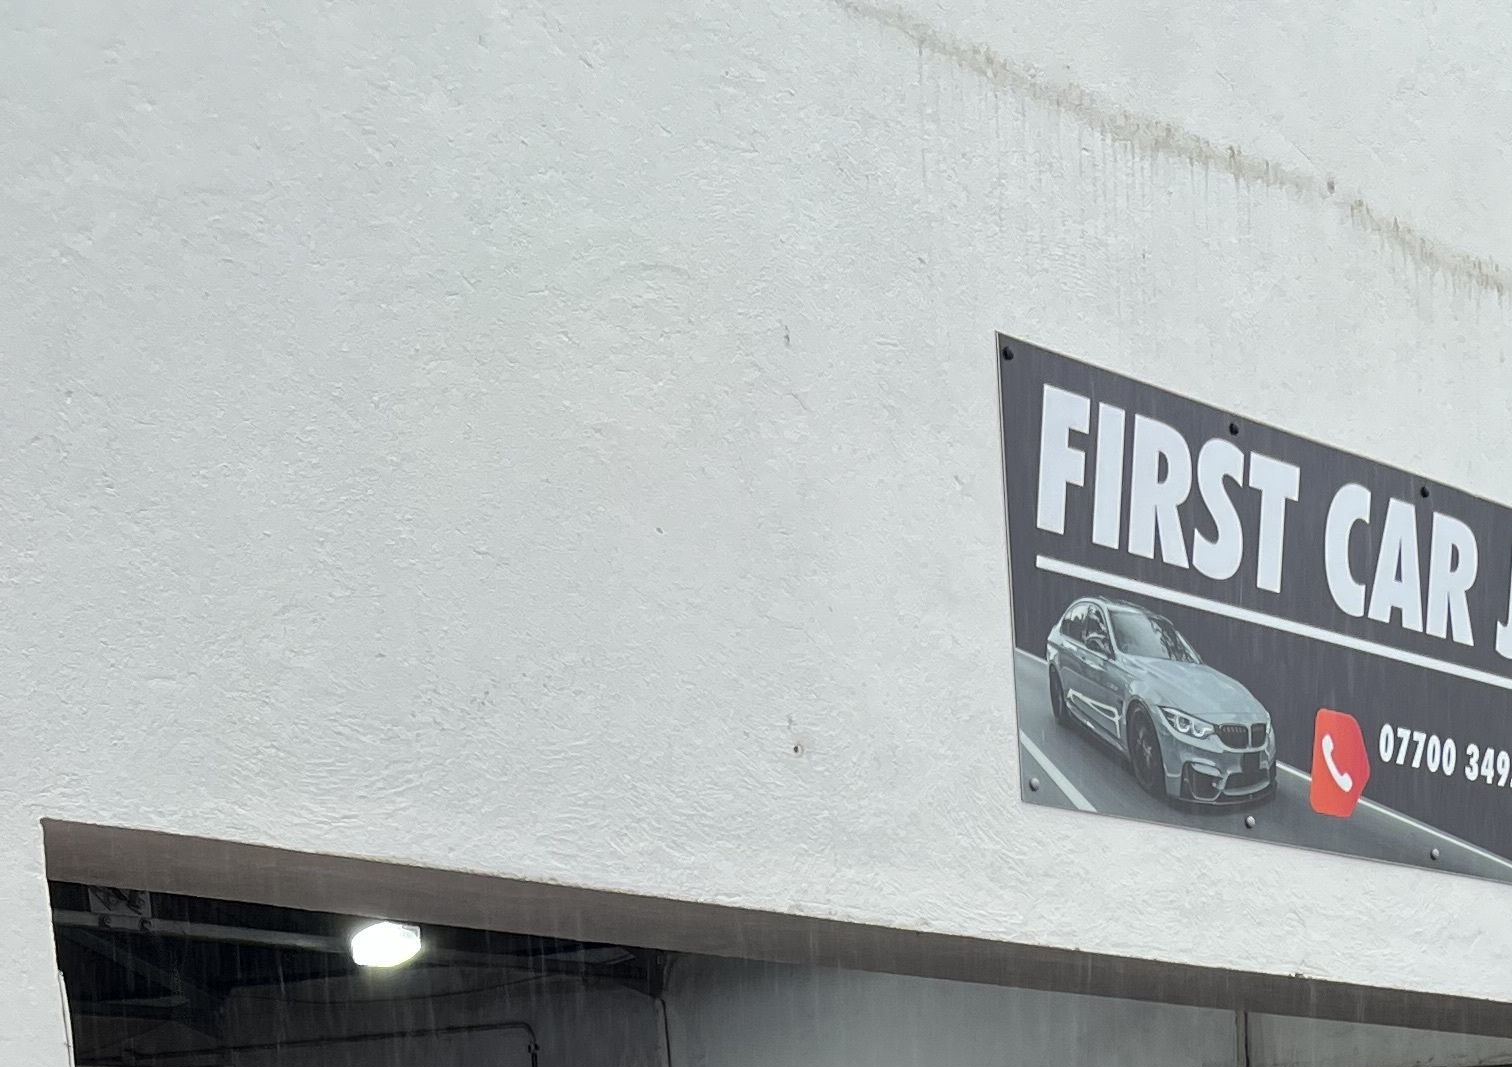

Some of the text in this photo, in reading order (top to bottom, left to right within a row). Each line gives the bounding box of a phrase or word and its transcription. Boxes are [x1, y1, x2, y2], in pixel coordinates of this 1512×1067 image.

[1036, 383, 1301, 594] FIRST
[1324, 482, 1479, 647] CAR
[1379, 723, 1457, 776] 07700
